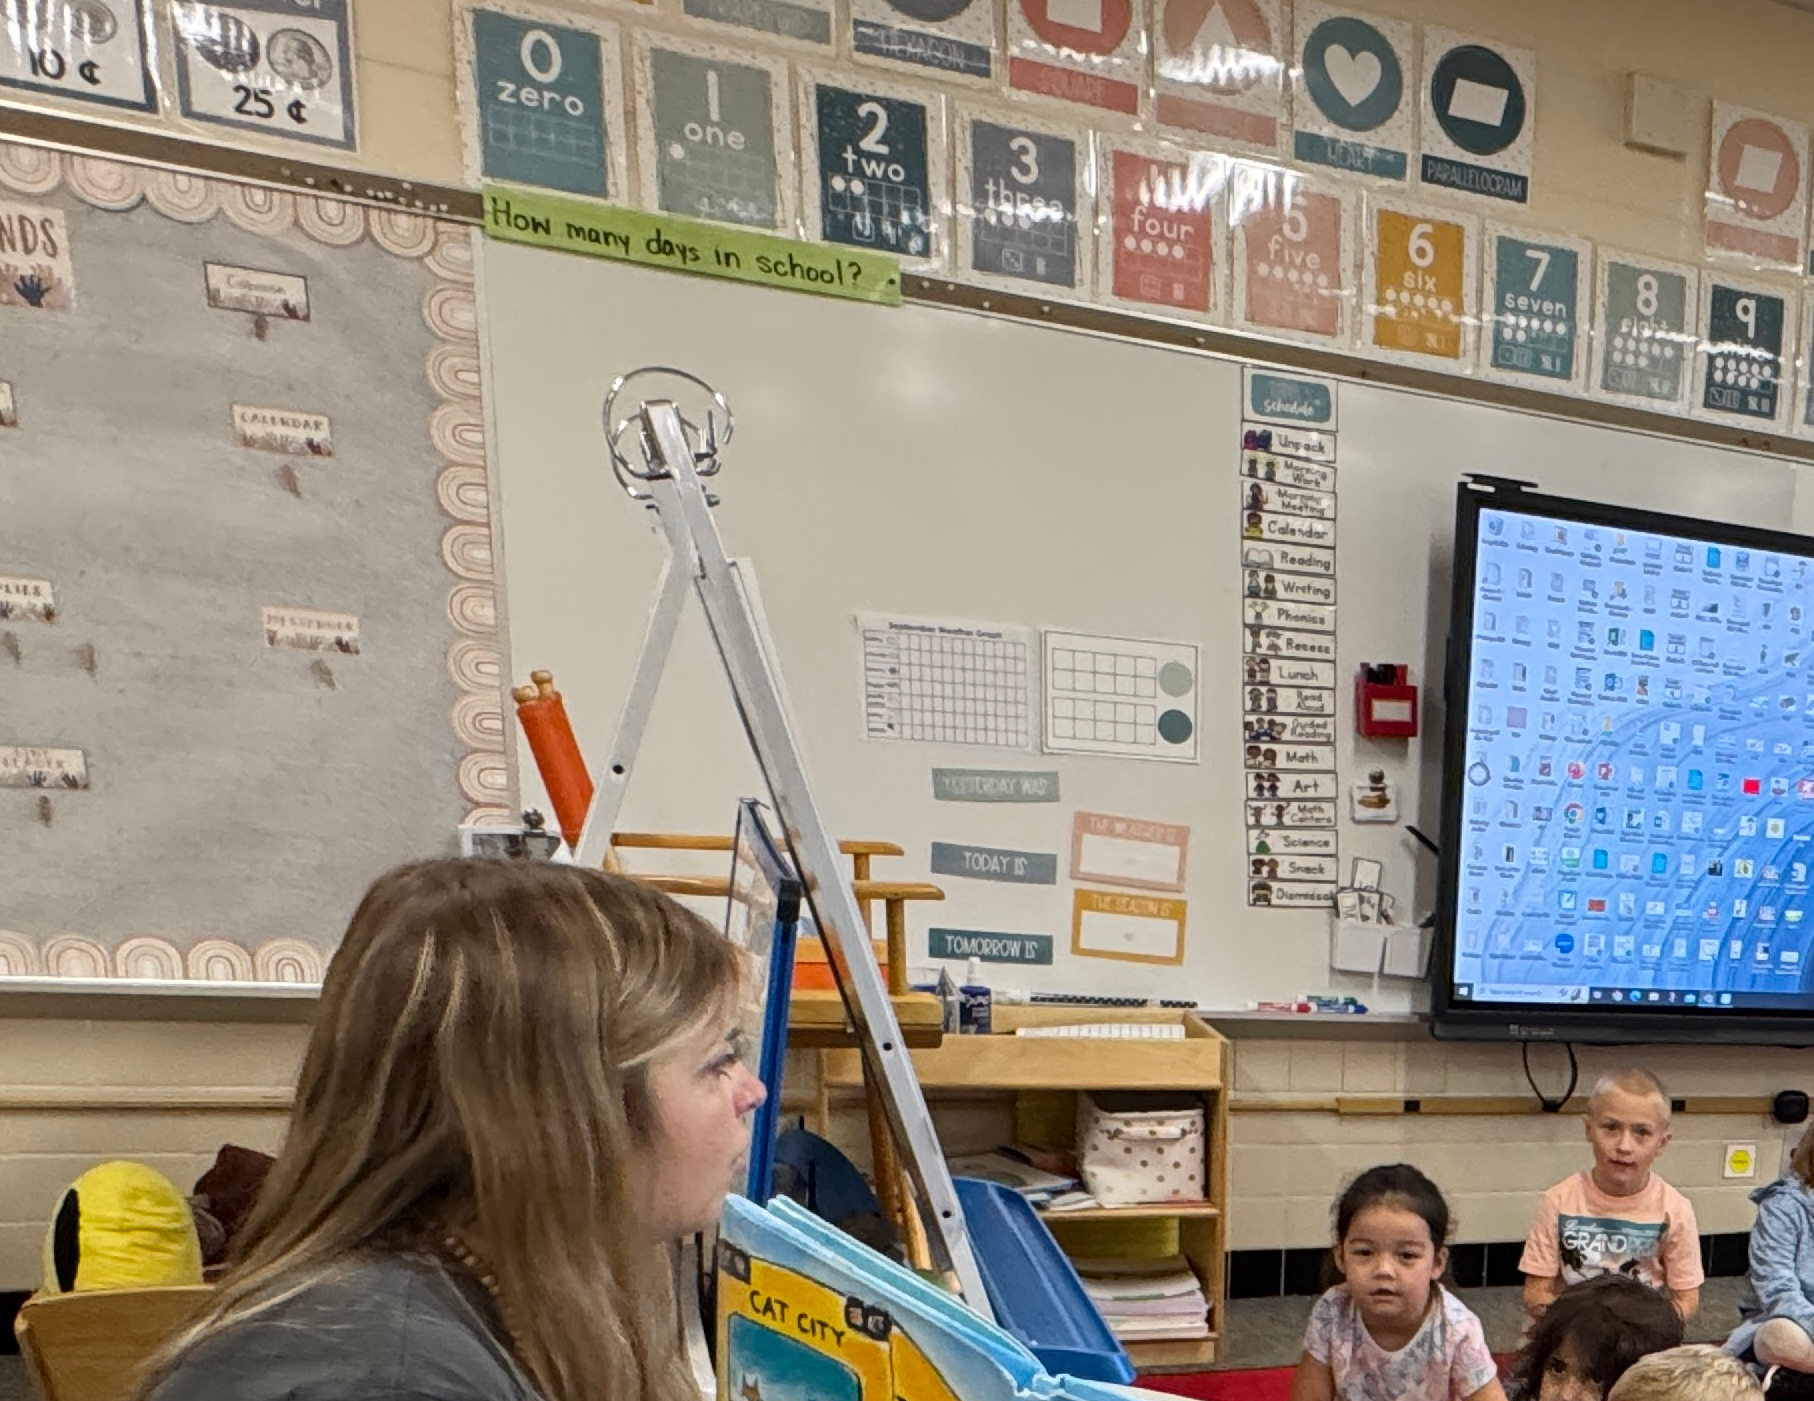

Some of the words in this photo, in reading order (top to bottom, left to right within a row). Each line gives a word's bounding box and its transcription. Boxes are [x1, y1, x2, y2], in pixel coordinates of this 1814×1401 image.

[520, 30, 563, 84] 0
[234, 86, 275, 119] 25
[496, 81, 585, 117] zero
[706, 70, 720, 122] 1
[684, 120, 746, 151] one
[858, 102, 890, 155] 2
[842, 146, 906, 182] two
[1009, 137, 1039, 184] 3
[1427, 160, 1525, 199] PARALLELOGRAM
[984, 178, 1064, 213] three
[1130, 208, 1194, 242] four
[1281, 196, 1308, 242] 5
[491, 199, 552, 236] How
[567, 223, 631, 256] many
[646, 228, 701, 265] days
[715, 245, 741, 270] in
[758, 254, 864, 287] school?
[1268, 235, 1321, 269] five
[1407, 224, 1435, 268] 6
[1402, 269, 1437, 294] six
[1524, 249, 1551, 293] 7
[1504, 293, 1567, 319] seven
[1637, 274, 1659, 316] 8
[1735, 298, 1758, 339] 9
[241, 412, 324, 431] CALENDAR
[1277, 433, 1326, 454] Unpack
[1284, 459, 1327, 481] Morning
[1292, 473, 1321, 488] Work
[1281, 500, 1326, 517] Meeting
[1268, 520, 1328, 540] Calendar
[1280, 552, 1331, 572] Reading
[1281, 579, 1331, 600] Writing
[1277, 607, 1326, 626] Phonics
[1286, 638, 1331, 655] Recess
[1278, 666, 1319, 682] Lunch
[1296, 690, 1324, 703] Read
[1286, 751, 1319, 765] Math
[943, 772, 1016, 797] YESTERDAY
[1293, 778, 1321, 794] Art
[1297, 803, 1325, 816] Math
[1282, 834, 1331, 848] Science
[963, 850, 1011, 876] TODAY
[1014, 856, 1028, 877] IS
[1288, 861, 1326, 876] Snack
[945, 934, 1020, 958] TOMORROW
[1024, 941, 1039, 960] IS
[1562, 1231, 1628, 1253] GRAND
[750, 1290, 789, 1325] CAT
[797, 1312, 846, 1349] CITY
